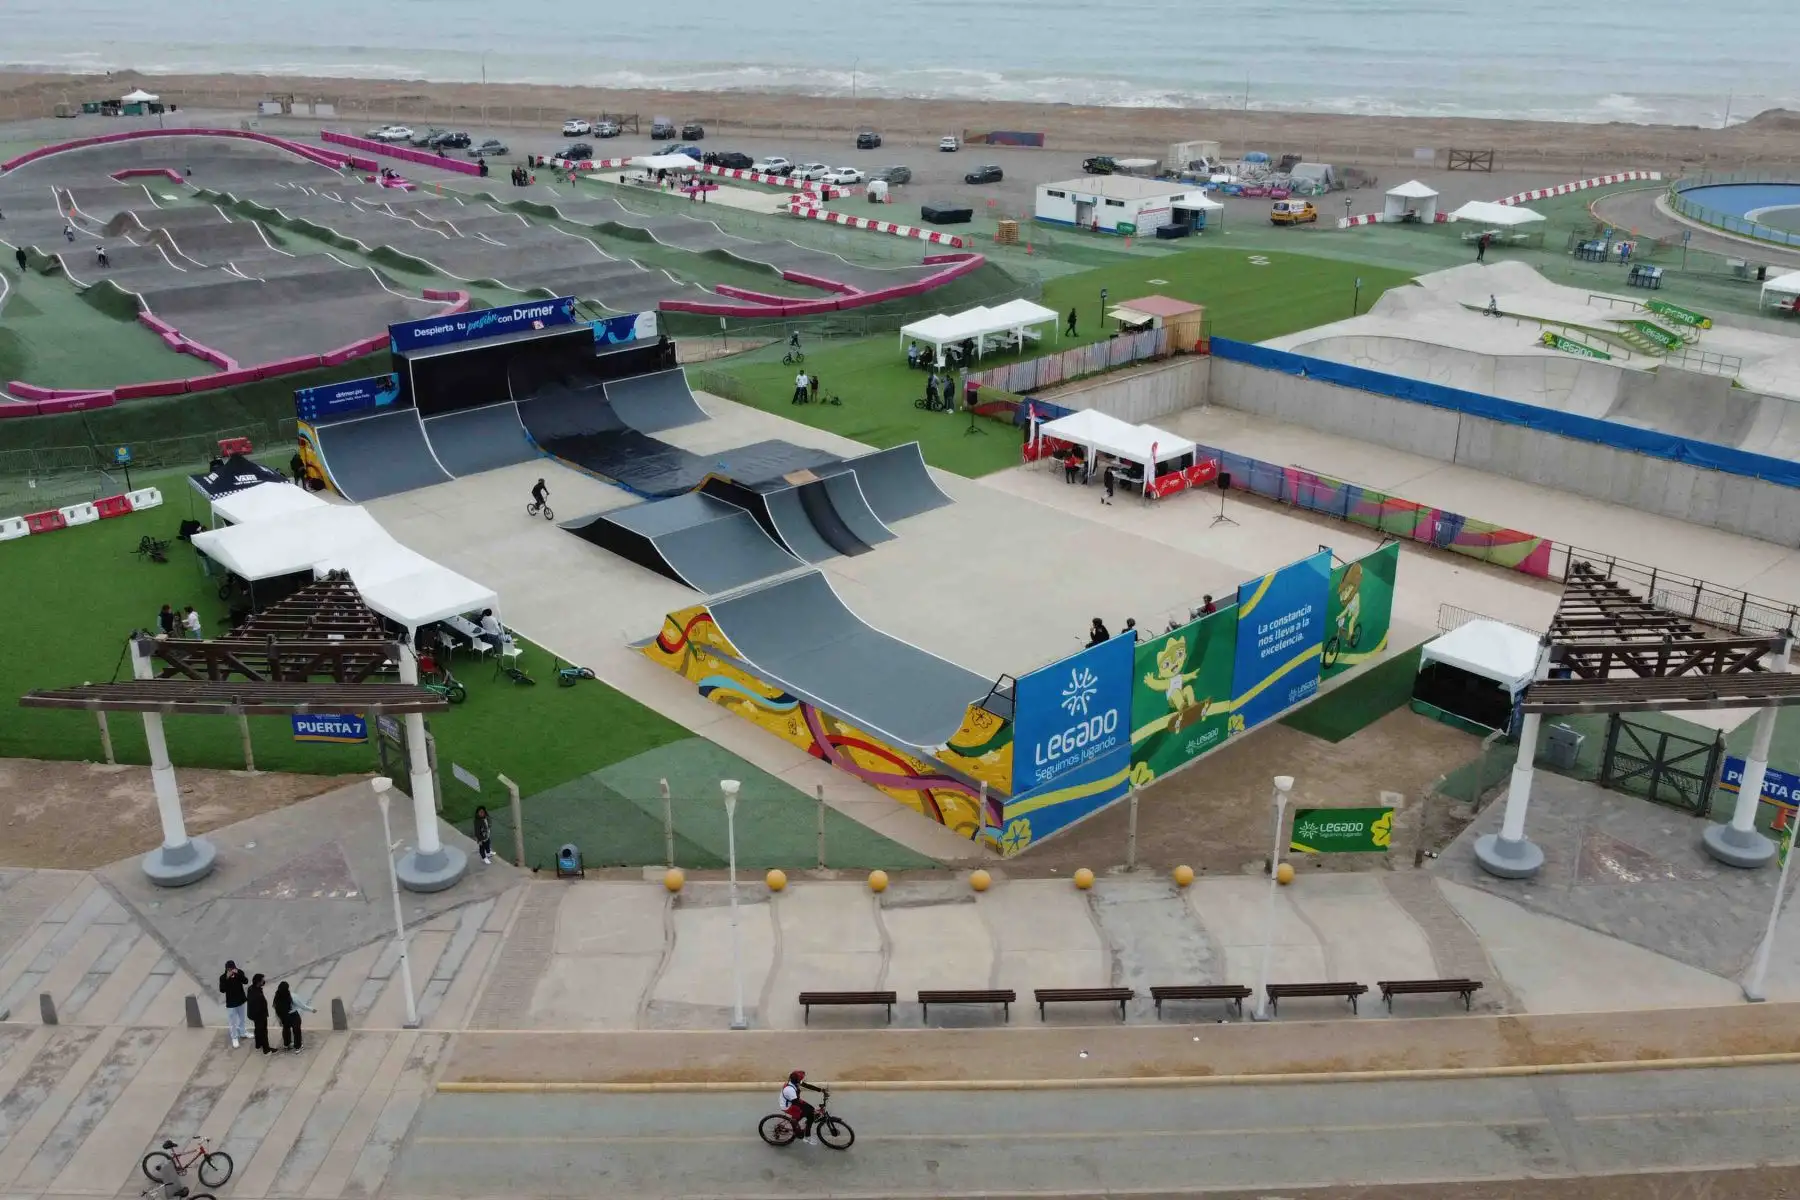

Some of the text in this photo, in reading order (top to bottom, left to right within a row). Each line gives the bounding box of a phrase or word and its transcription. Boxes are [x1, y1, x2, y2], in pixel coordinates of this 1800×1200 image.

[414, 324, 454, 338] Despierta
[457, 321, 466, 331] tu
[497, 314, 513, 325] con
[513, 304, 554, 321] Drimer
[1257, 603, 1312, 635] La constancia
[1258, 616, 1310, 648] nos lleva a la
[297, 721, 362, 734] PUERTA 7
[1035, 735, 1116, 782] Seguimos jugando
[1791, 789, 1800, 801] 6
